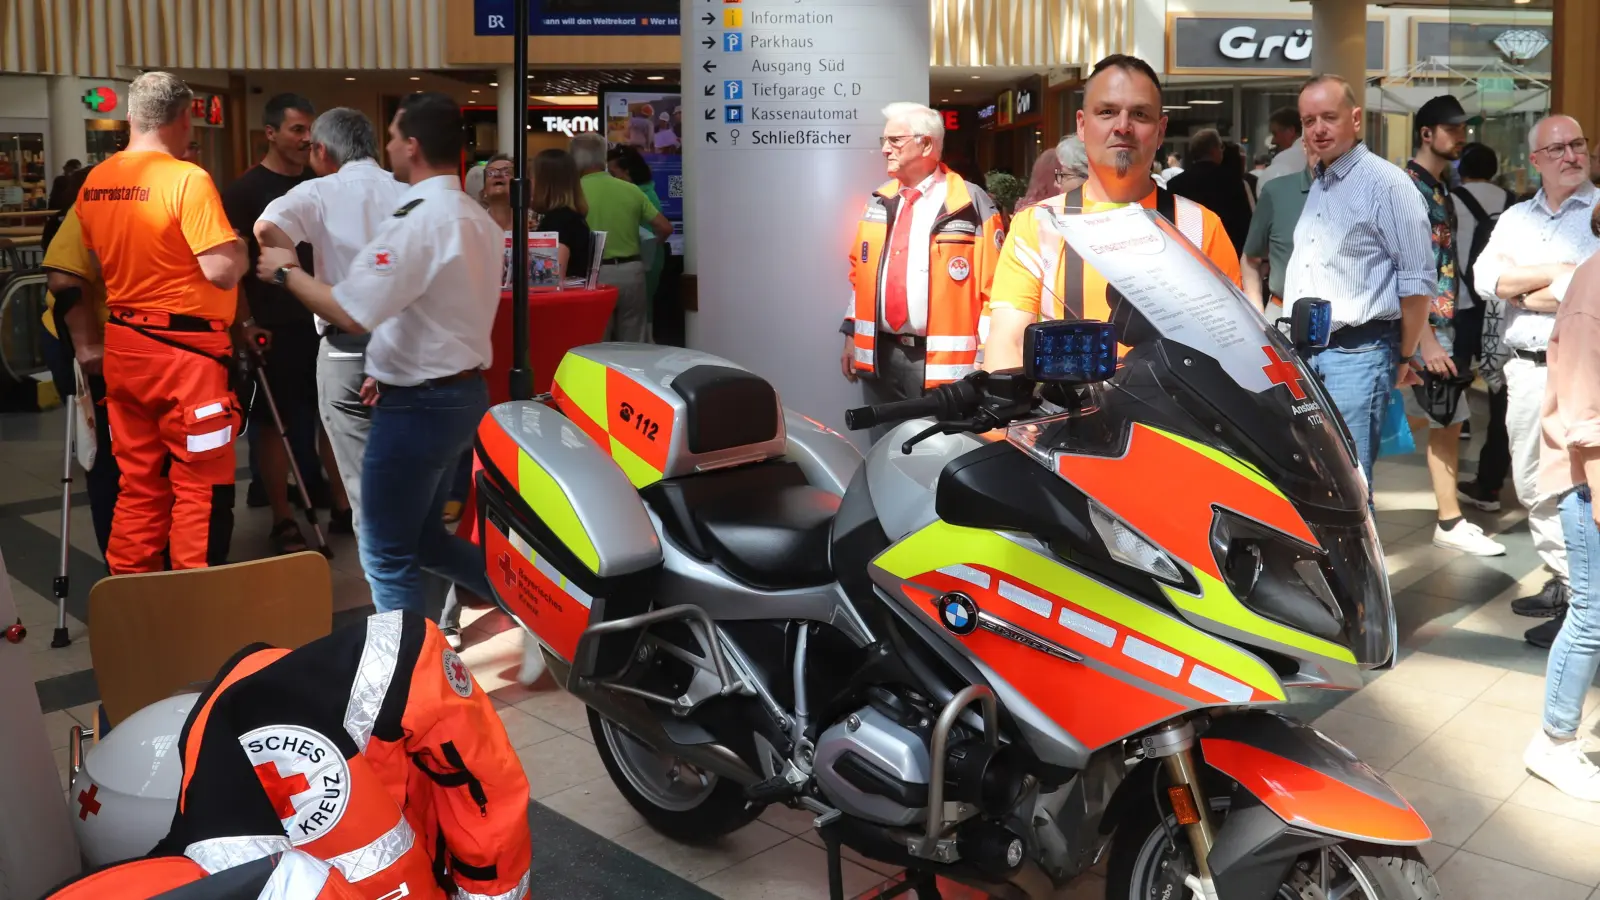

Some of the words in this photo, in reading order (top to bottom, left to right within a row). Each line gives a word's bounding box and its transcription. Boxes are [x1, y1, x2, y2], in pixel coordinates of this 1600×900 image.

[488, 15, 505, 28] BR
[562, 17, 575, 25] will
[577, 17, 592, 25] den
[593, 17, 636, 25] Weltrekord
[650, 17, 666, 25] Wer
[667, 17, 678, 25] ist
[751, 10, 833, 24] Information
[751, 35, 814, 48] Parkhaus
[1219, 26, 1312, 60] Grü
[751, 59, 811, 75] Ausgang
[818, 58, 845, 72] Süd
[752, 83, 825, 99] Tiefgarage
[833, 83, 847, 98] C,
[852, 83, 861, 96] D
[751, 107, 858, 120] Kassenautomat
[752, 130, 851, 144] Schließfächer
[635, 413, 659, 441] 112
[519, 567, 563, 612] Bayerisches
[519, 580, 538, 604] Rotes
[248, 736, 326, 763] SCHES
[298, 773, 341, 836] KREUZ
